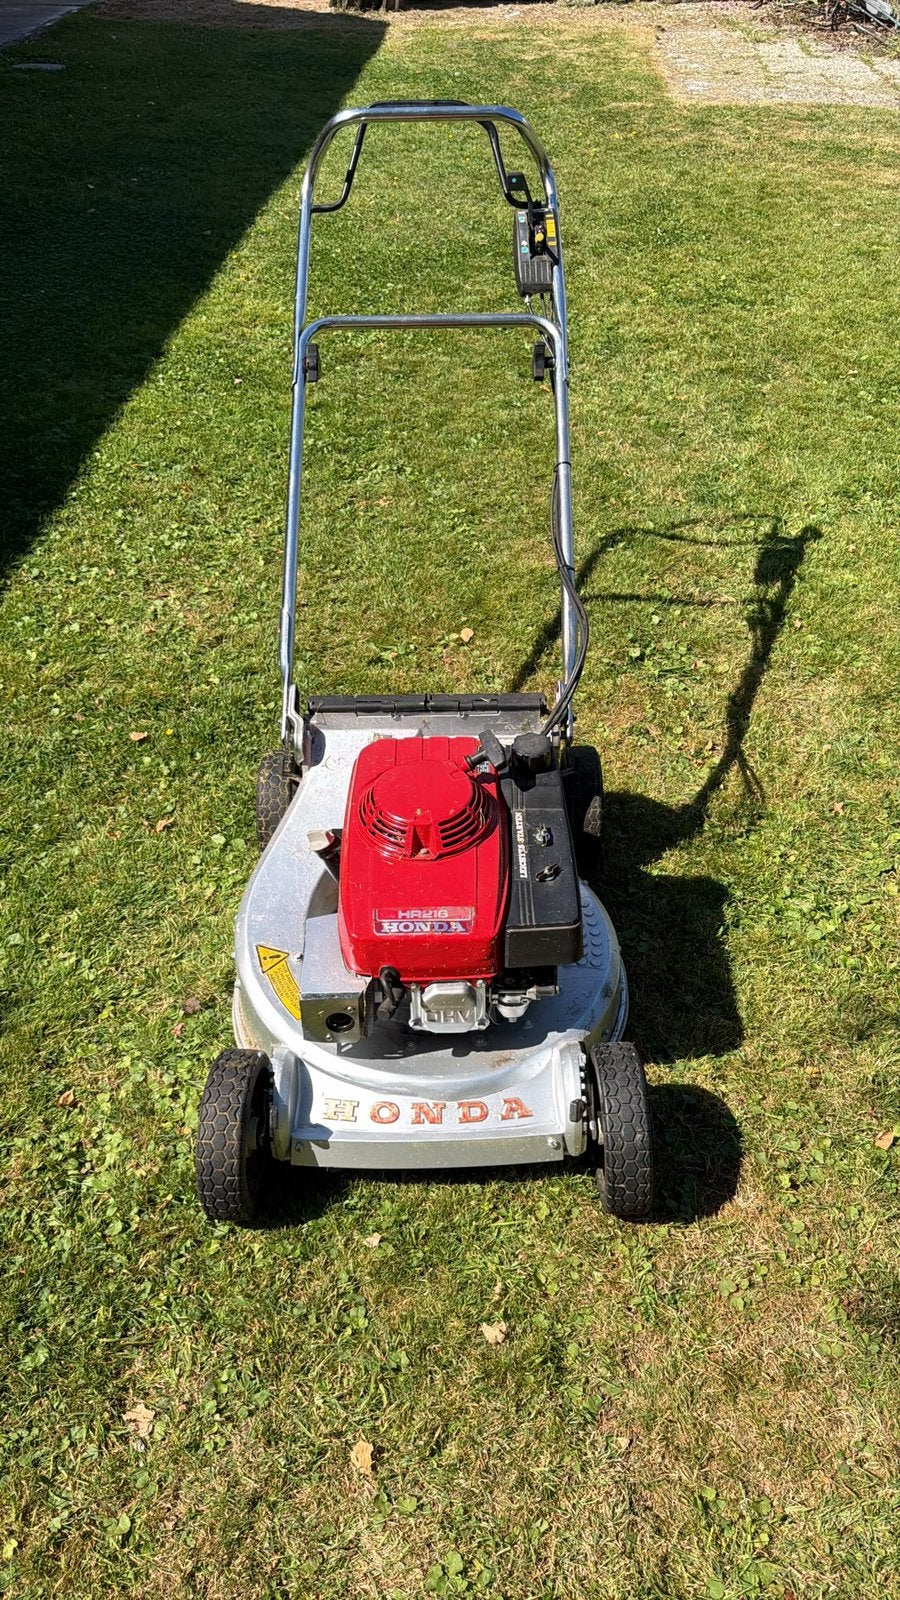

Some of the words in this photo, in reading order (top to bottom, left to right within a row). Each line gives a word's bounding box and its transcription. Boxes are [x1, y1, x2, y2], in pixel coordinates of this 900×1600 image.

[515, 812, 525, 844] STARTEN
[398, 909, 449, 919] HR216
[381, 921, 466, 933] HONDA
[323, 1097, 534, 1124] HONDA
